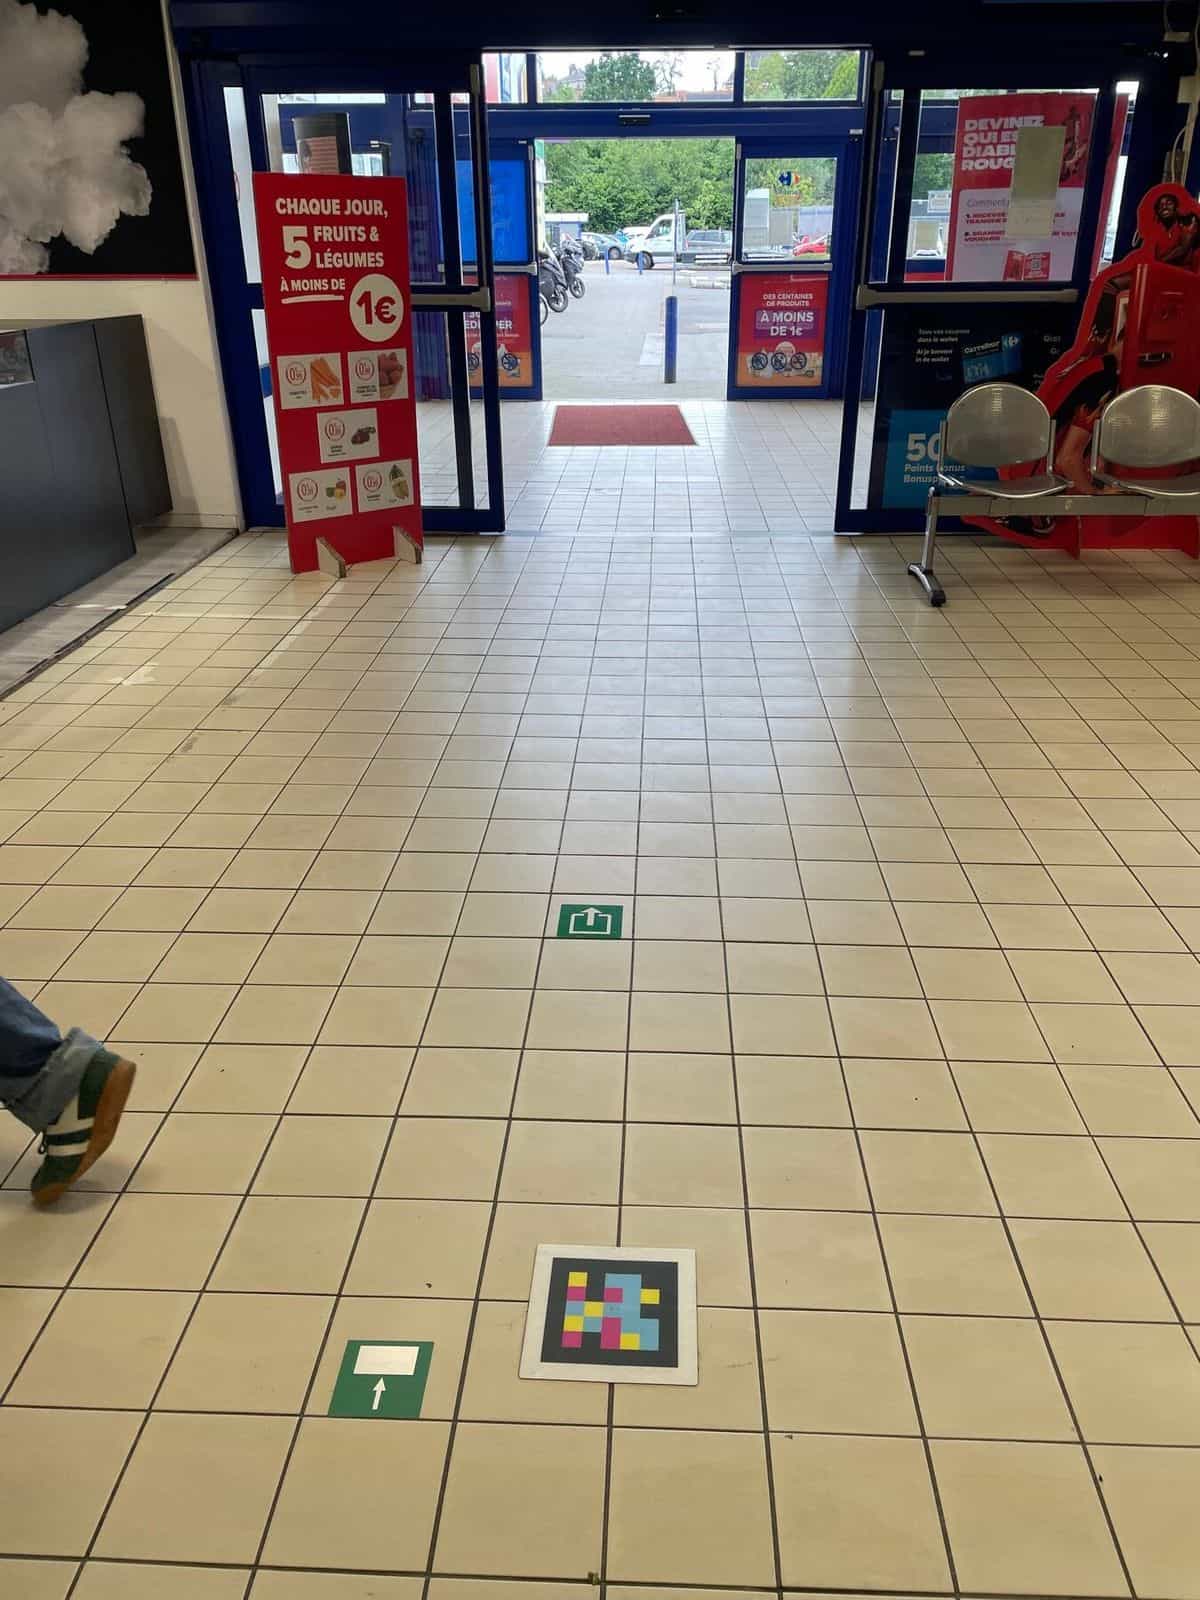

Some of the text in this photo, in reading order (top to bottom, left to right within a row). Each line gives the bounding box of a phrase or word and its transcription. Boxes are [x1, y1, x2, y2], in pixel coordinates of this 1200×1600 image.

[965, 115, 1044, 131] DEVINEZ
[964, 130, 1018, 145] QUI ES
[961, 157, 1016, 170] ROUG
[275, 198, 388, 218] CHAQUE JOUR,
[282, 225, 379, 269] 5 FRUITS &
[315, 248, 384, 268] LÉGUMES
[280, 276, 345, 291] À MOINS DE
[356, 290, 396, 325] 1€
[760, 310, 814, 322] À MOINS
[770, 326, 787, 336] DE
[904, 464, 966, 472] Points onus
